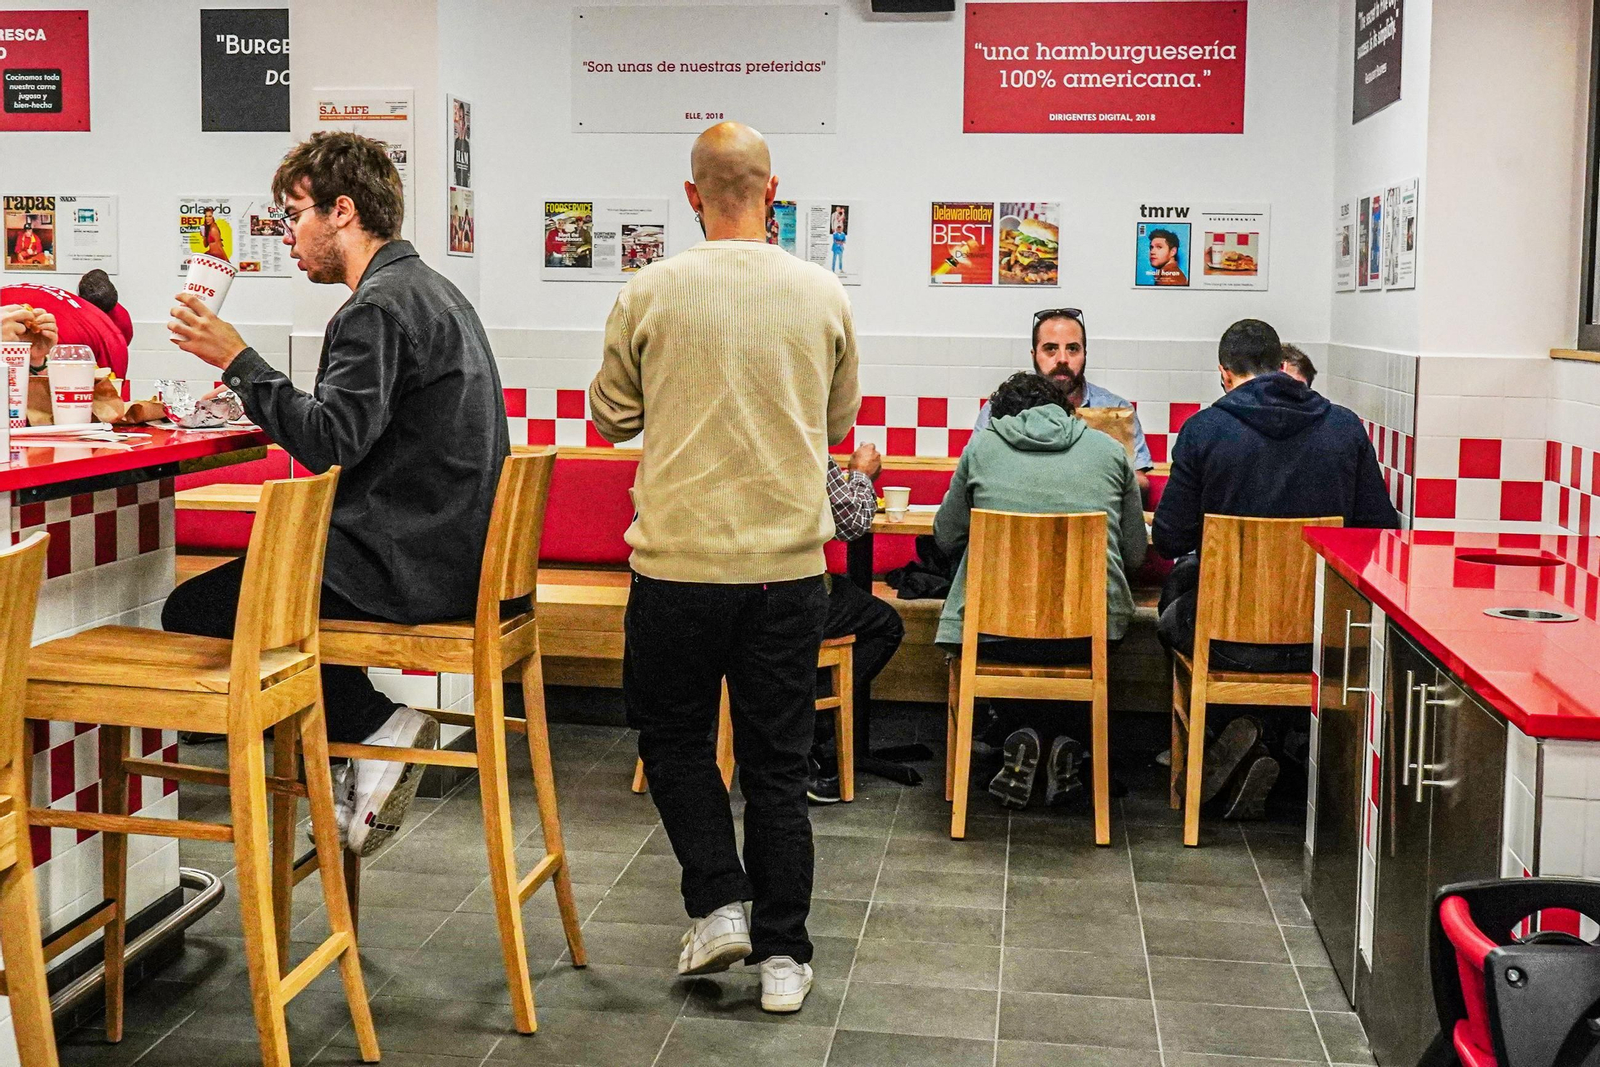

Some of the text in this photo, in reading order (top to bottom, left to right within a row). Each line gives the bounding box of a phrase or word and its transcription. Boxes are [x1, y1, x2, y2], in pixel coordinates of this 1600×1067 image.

[1035, 40, 1237, 65] hamburguesería
[582, 60, 827, 75] "Son unas de nuestras preferidas"
[5, 73, 60, 81] Cocinamos toda
[1000, 69, 1057, 88] 100%
[18, 92, 48, 101] jugosa y
[14, 101, 53, 109] bien-hecha
[319, 105, 369, 115] S.A. LIFE
[685, 112, 724, 121] ELLE, 2018
[1049, 113, 1156, 122] DIRIGENTES DIGITAL, 2018
[180, 203, 232, 215] Orlado
[1140, 203, 1191, 218] tmrw
[181, 216, 203, 225] BEST
[933, 223, 992, 245] BEST
[187, 282, 216, 298] GUYS
[74, 393, 93, 401] FIVE
